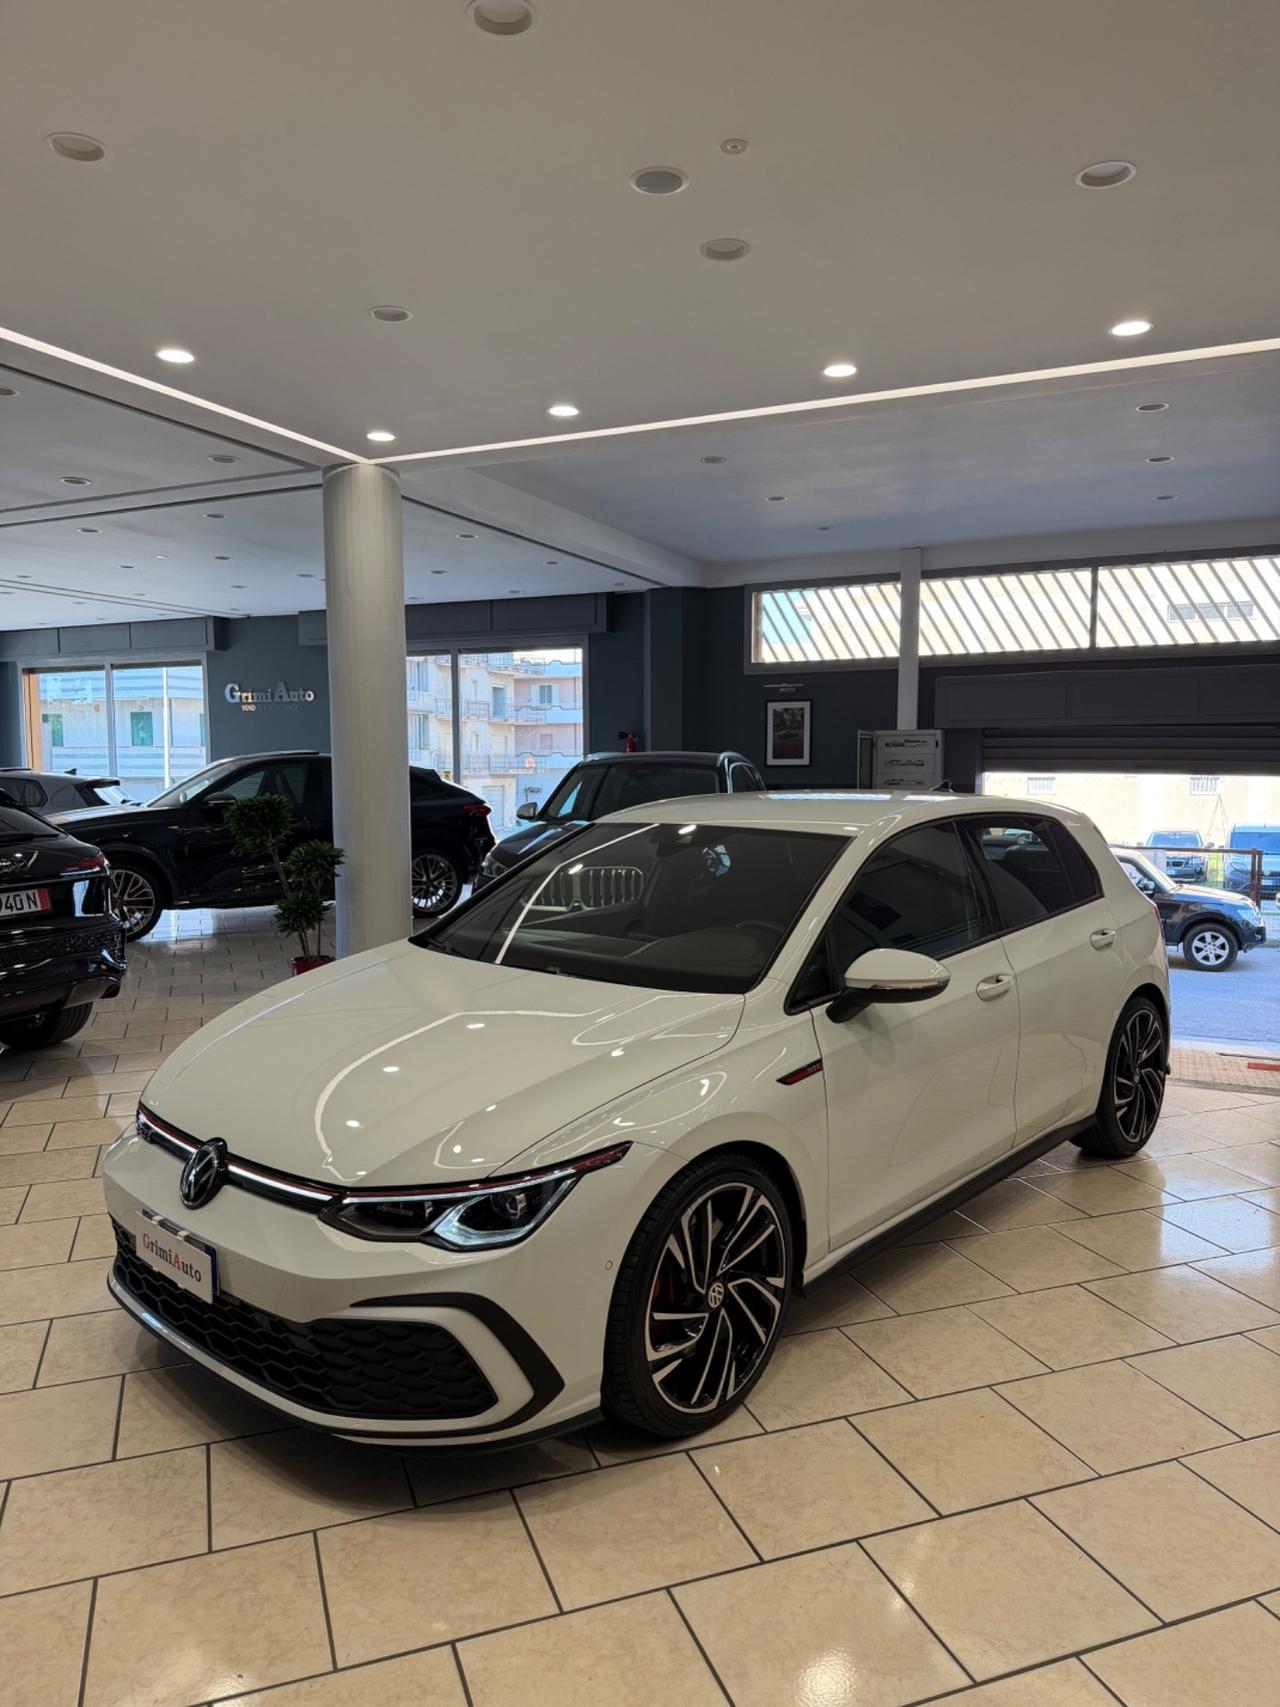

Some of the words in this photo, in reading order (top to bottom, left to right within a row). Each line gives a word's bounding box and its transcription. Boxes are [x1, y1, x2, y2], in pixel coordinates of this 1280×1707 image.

[224, 682, 272, 703] Grimi
[274, 681, 314, 702] Auto
[142, 1232, 202, 1282] GrimiAuto
